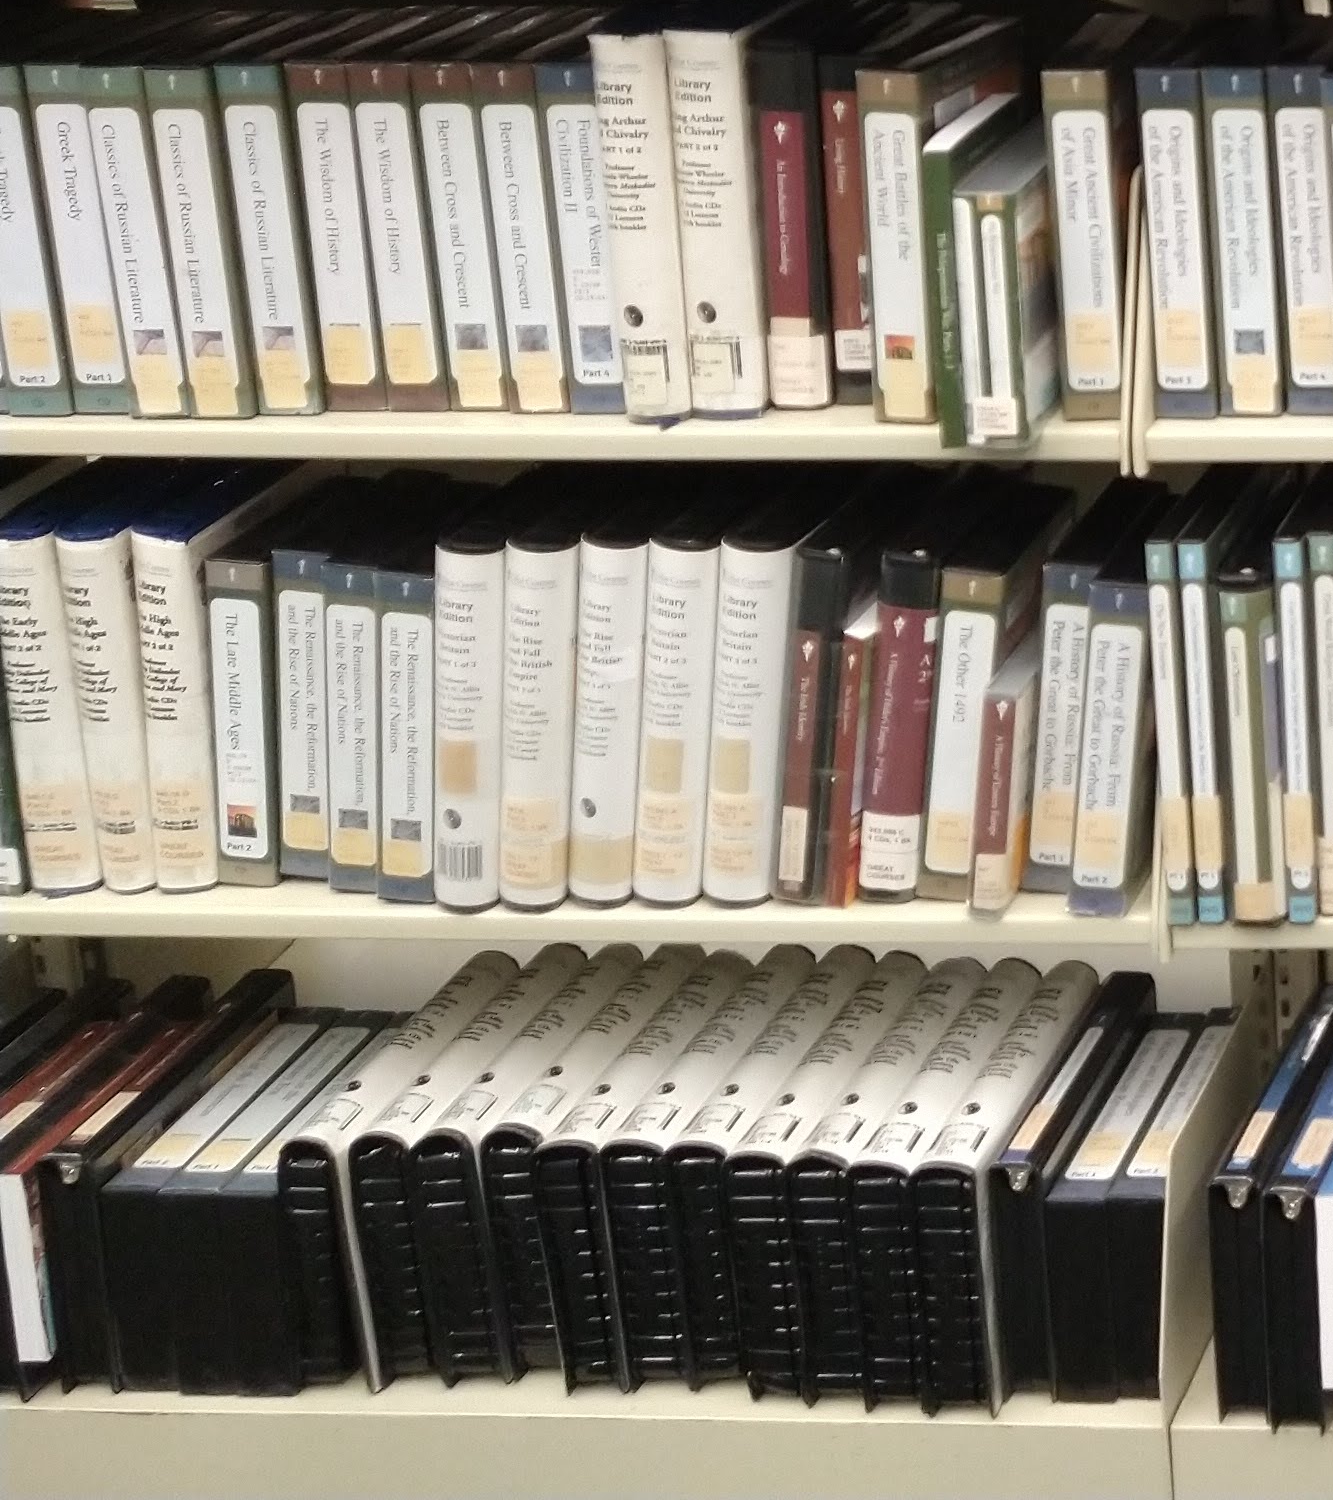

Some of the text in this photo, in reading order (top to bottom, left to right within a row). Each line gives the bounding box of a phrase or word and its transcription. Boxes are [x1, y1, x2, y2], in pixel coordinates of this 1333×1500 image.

[674, 78, 711, 92] Library
[606, 130, 650, 140] Chivalry
[612, 116, 647, 126] Arthur
[684, 127, 727, 139] Chivalry
[690, 114, 725, 123] Arthur
[57, 121, 83, 222] Greek Tragedy
[556, 118, 575, 198] Civilization
[315, 119, 340, 276] The Wisdom of History
[373, 118, 401, 274] The Wisdom of History
[436, 119, 469, 308] Between Cross and Crescent
[500, 121, 531, 309] Between Cross and Crescent
[577, 119, 601, 268] Foundations of Wester
[101, 124, 143, 323] Classics of Russian Literature
[167, 123, 204, 323] Classics of Russian Literature
[242, 121, 278, 320] Classics of Russian Literature
[19, 374, 45, 383] Part 2
[86, 373, 104, 382] Part
[583, 368, 610, 378] Part 4
[304, 606, 316, 630] The
[352, 621, 364, 644] The
[407, 628, 419, 652] The
[225, 613, 242, 751] The Late Middle Ages
[288, 604, 301, 731] and the Rise of Nations
[335, 619, 349, 745] and the Rise of Nations
[389, 627, 401, 754] and the Rise of Nations
[952, 624, 974, 723] The Other 1492
[306, 703, 318, 721] the
[354, 715, 366, 734] the
[407, 723, 419, 742] the
[227, 843, 245, 851] Part
